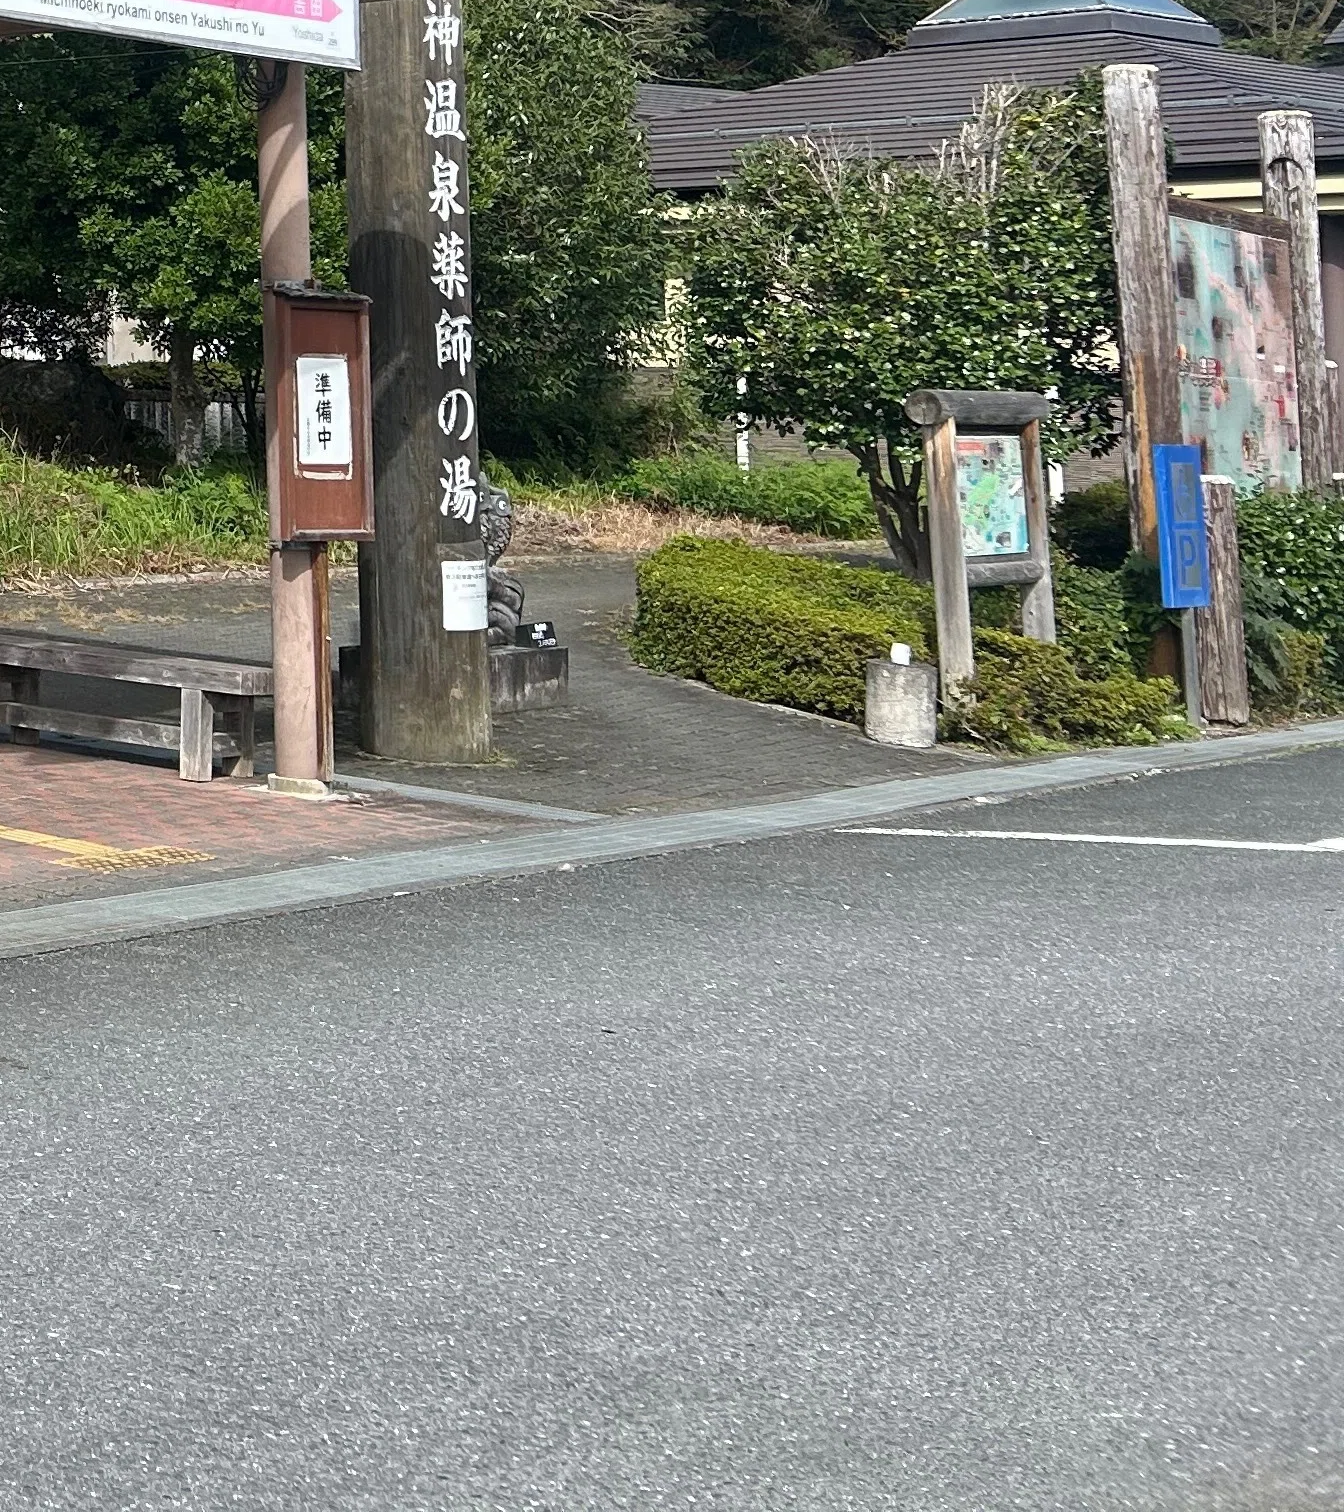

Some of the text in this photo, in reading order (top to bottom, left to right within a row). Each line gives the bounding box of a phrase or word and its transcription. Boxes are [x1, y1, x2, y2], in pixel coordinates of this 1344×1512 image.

[106, 0, 152, 23] ryokami
[154, 8, 188, 26] onsen
[191, 11, 233, 33] Yakushi
[235, 21, 249, 34] no
[251, 21, 265, 37] Yu
[314, 372, 333, 451] 準備中
[1178, 534, 1197, 587] P
